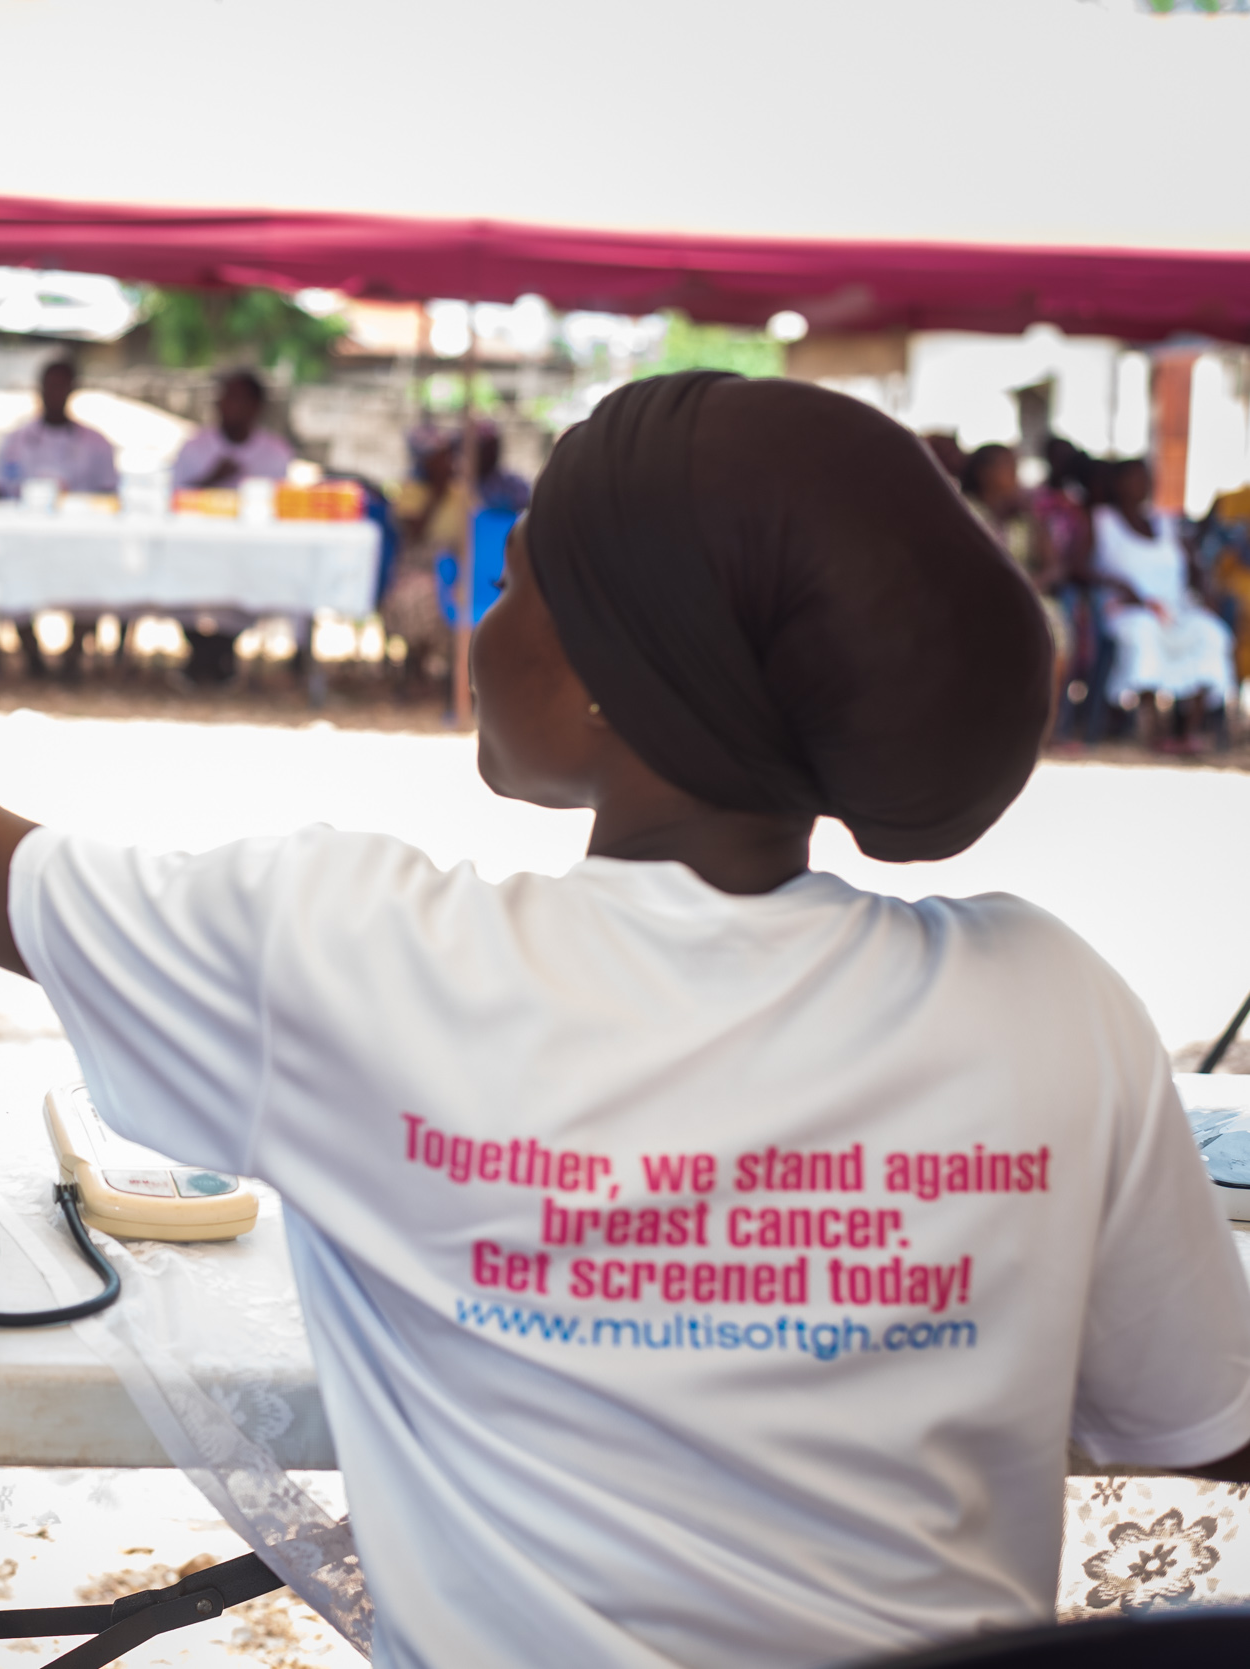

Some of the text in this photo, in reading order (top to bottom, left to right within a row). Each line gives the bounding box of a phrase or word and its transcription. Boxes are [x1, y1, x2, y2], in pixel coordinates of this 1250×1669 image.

[401, 1112, 1051, 1203] Together, we stand against
[540, 1195, 912, 1251] breast cancer.
[471, 1239, 974, 1314] Get screened today!
[453, 1299, 977, 1361] www.multisoftgh.com
